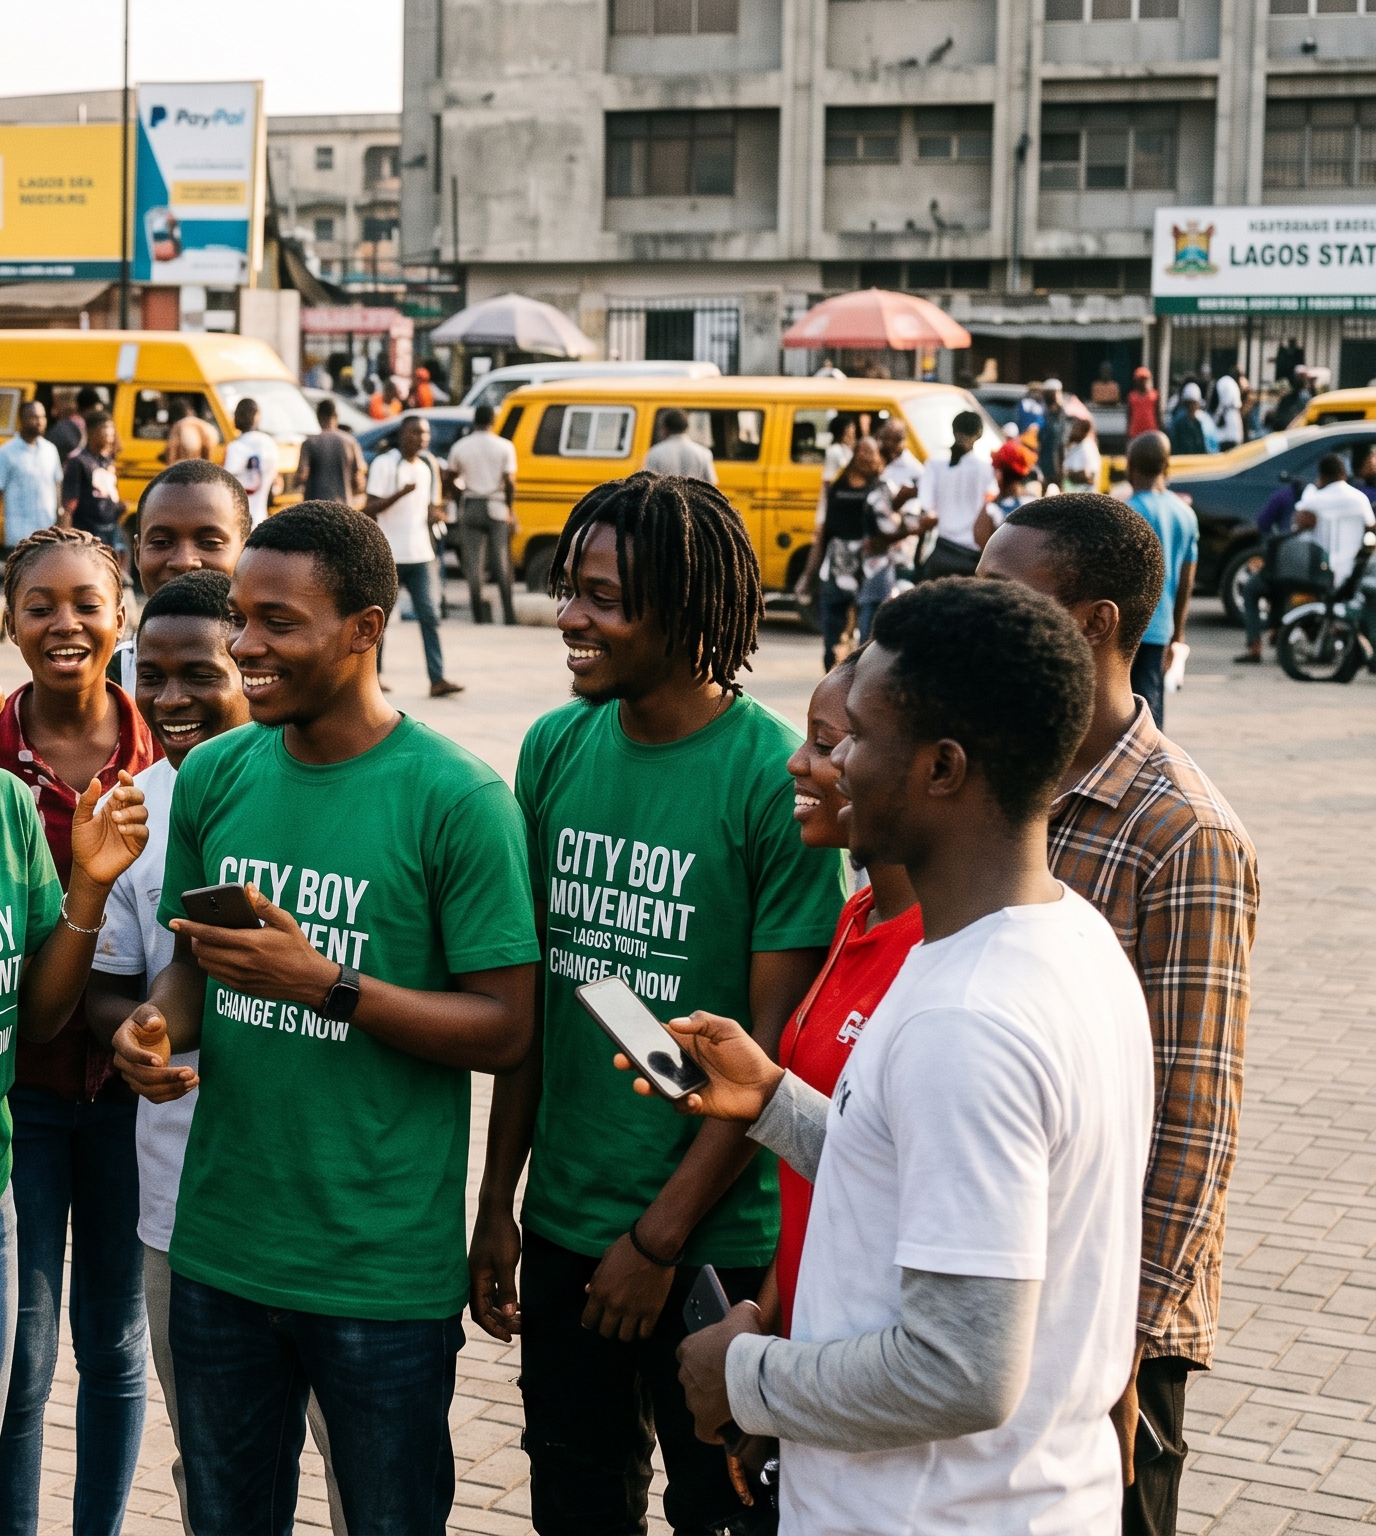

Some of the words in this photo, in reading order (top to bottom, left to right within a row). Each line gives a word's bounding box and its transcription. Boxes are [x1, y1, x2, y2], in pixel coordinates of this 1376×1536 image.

[1230, 244, 1310, 266] LAGOS
[1319, 244, 1376, 266] STAT
[556, 827, 626, 882] CITY
[628, 840, 696, 897] BOY
[296, 868, 370, 925] BOY
[550, 876, 696, 942] MOVEMENT
[573, 926, 611, 950] LAGOS
[614, 934, 648, 959] YOUTH
[549, 947, 612, 984] CHANGE
[634, 968, 681, 1002] NOW
[217, 988, 277, 1029] CHANGE
[279, 1004, 298, 1033] IS
[301, 1009, 349, 1042] NOW
